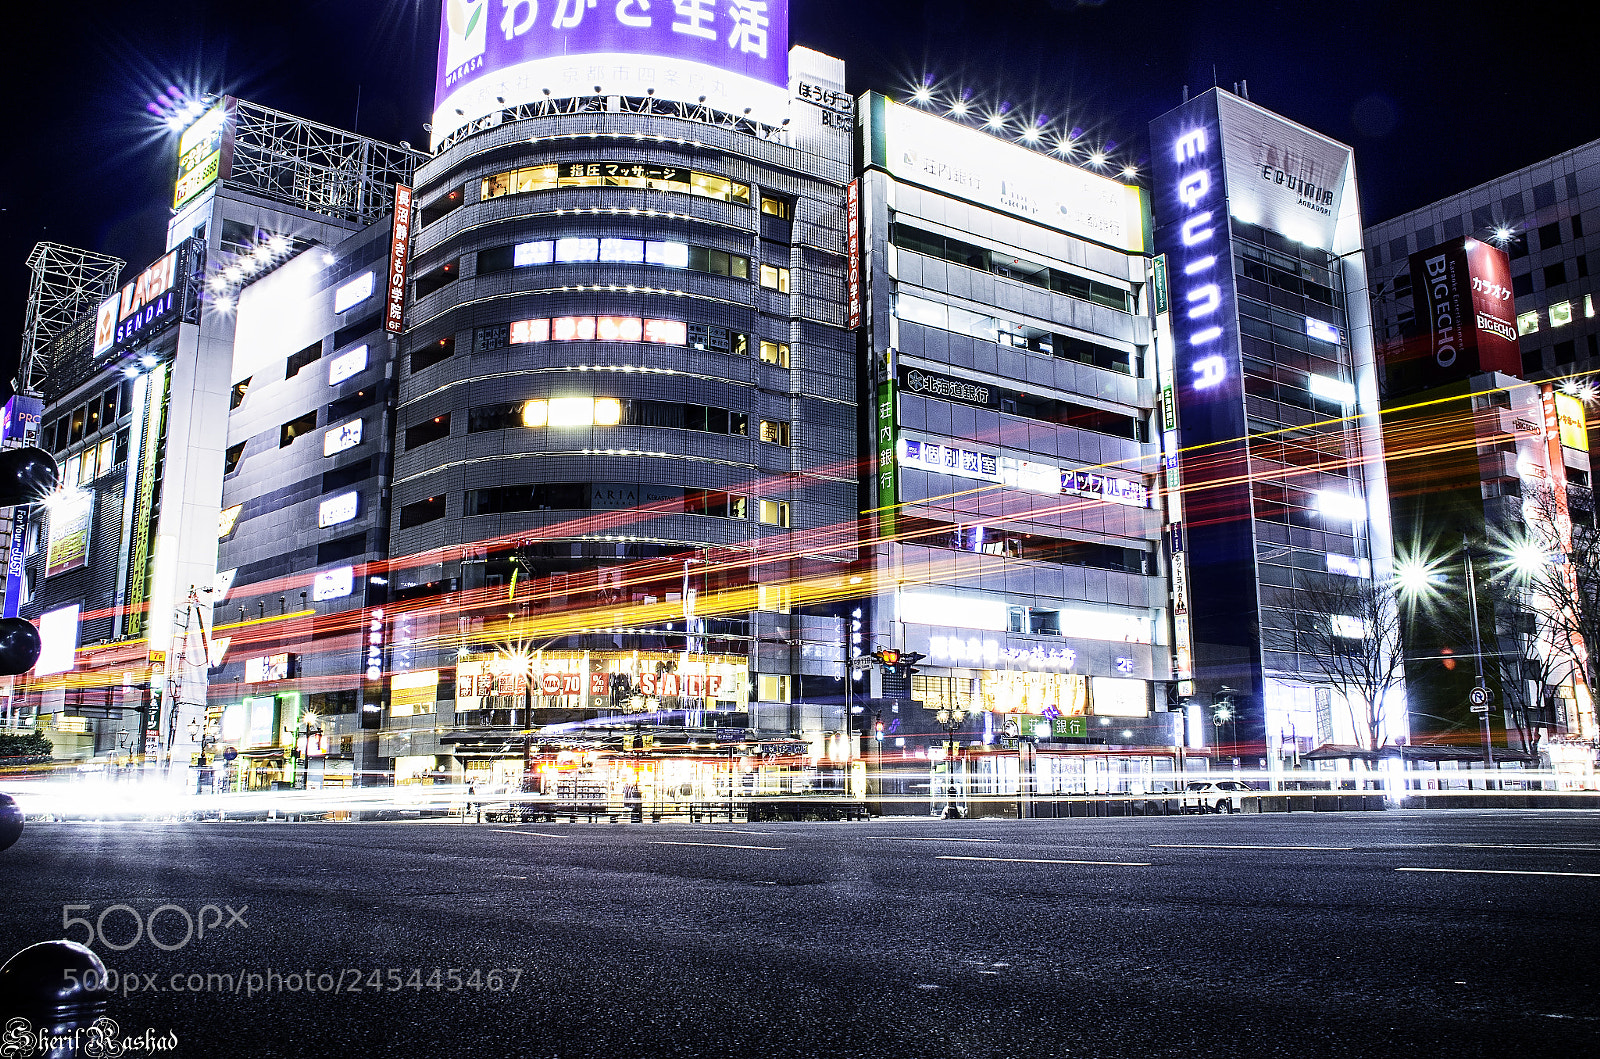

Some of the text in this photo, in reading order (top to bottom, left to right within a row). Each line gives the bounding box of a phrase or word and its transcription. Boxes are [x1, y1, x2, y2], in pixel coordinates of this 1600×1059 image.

[446, 55, 484, 88] WAKASA
[569, 163, 676, 180] 指圧マッサージ
[119, 250, 177, 322] LABI
[1472, 276, 1511, 301] カラオケ
[117, 292, 173, 343] SENDAI
[388, 320, 400, 331] 6F
[924, 375, 989, 403] 北海道銀行
[879, 401, 893, 490] 荘内銀行
[924, 443, 997, 475] 個別教室
[594, 490, 635, 501] ARIA
[9, 548, 23, 577] JUST
[153, 652, 163, 660] 7F
[1116, 657, 1133, 672] 2F
[544, 680, 558, 688] MAX
[563, 676, 580, 692] 70
[641, 673, 719, 696] SALE
[1029, 718, 1081, 735] 荘銀行
